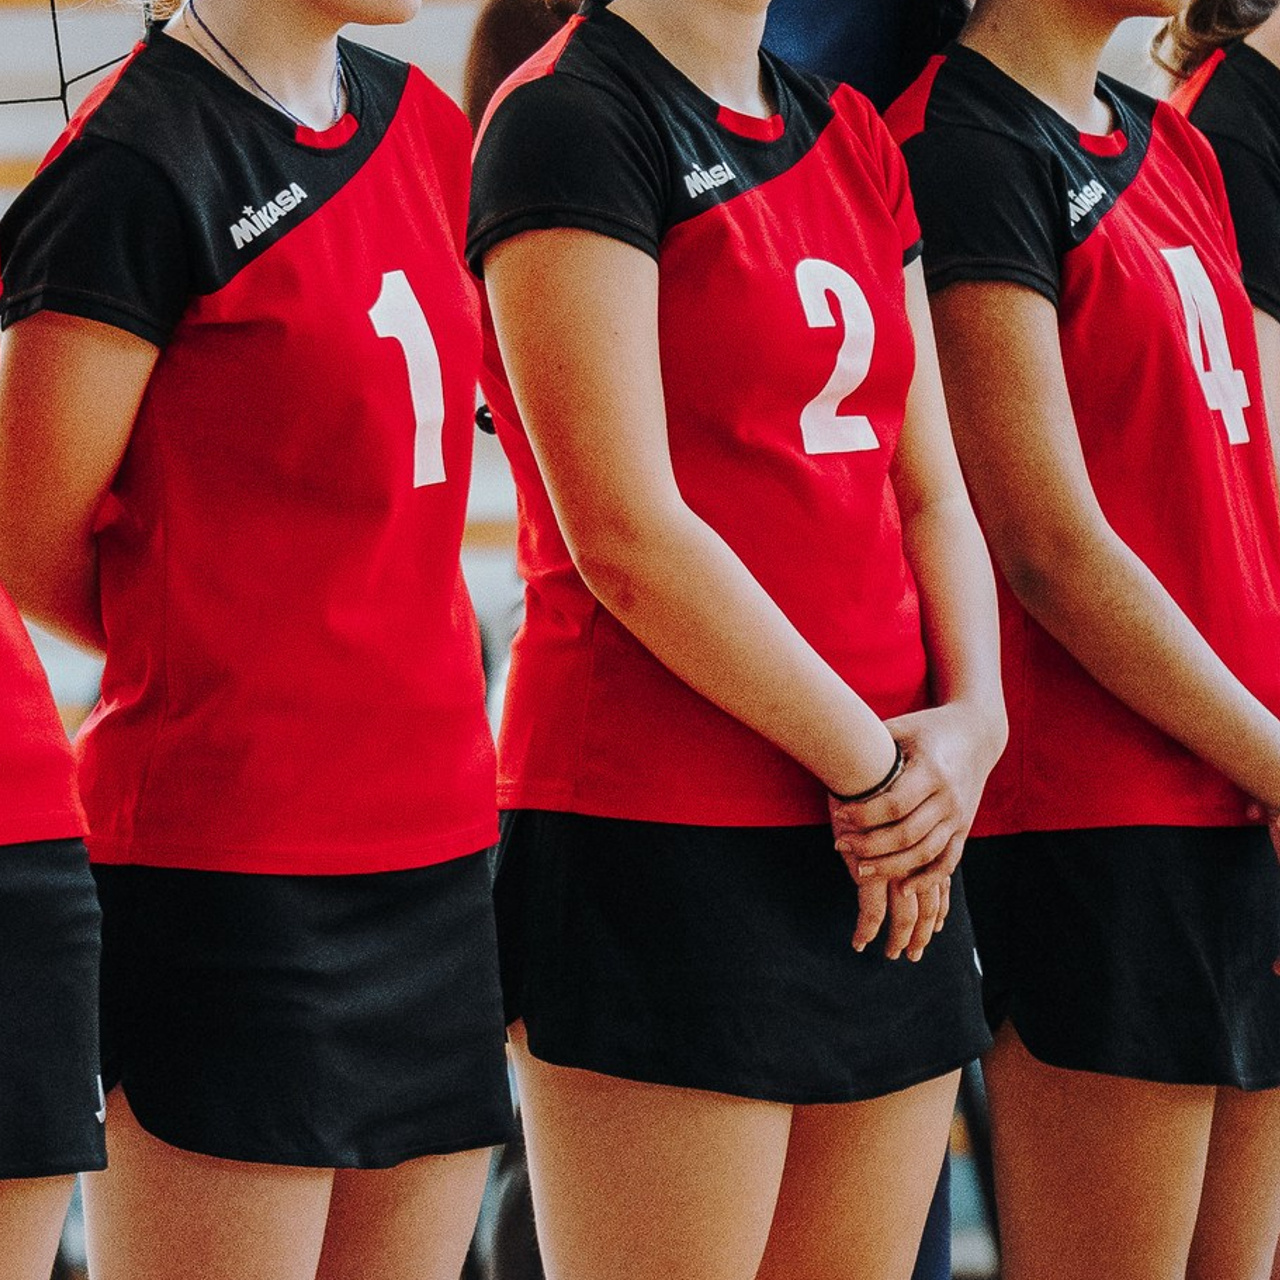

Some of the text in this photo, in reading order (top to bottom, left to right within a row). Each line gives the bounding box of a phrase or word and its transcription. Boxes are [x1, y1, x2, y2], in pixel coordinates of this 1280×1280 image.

[368, 270, 446, 488] 1
[795, 258, 879, 454] 2
[1159, 246, 1250, 444] 4
